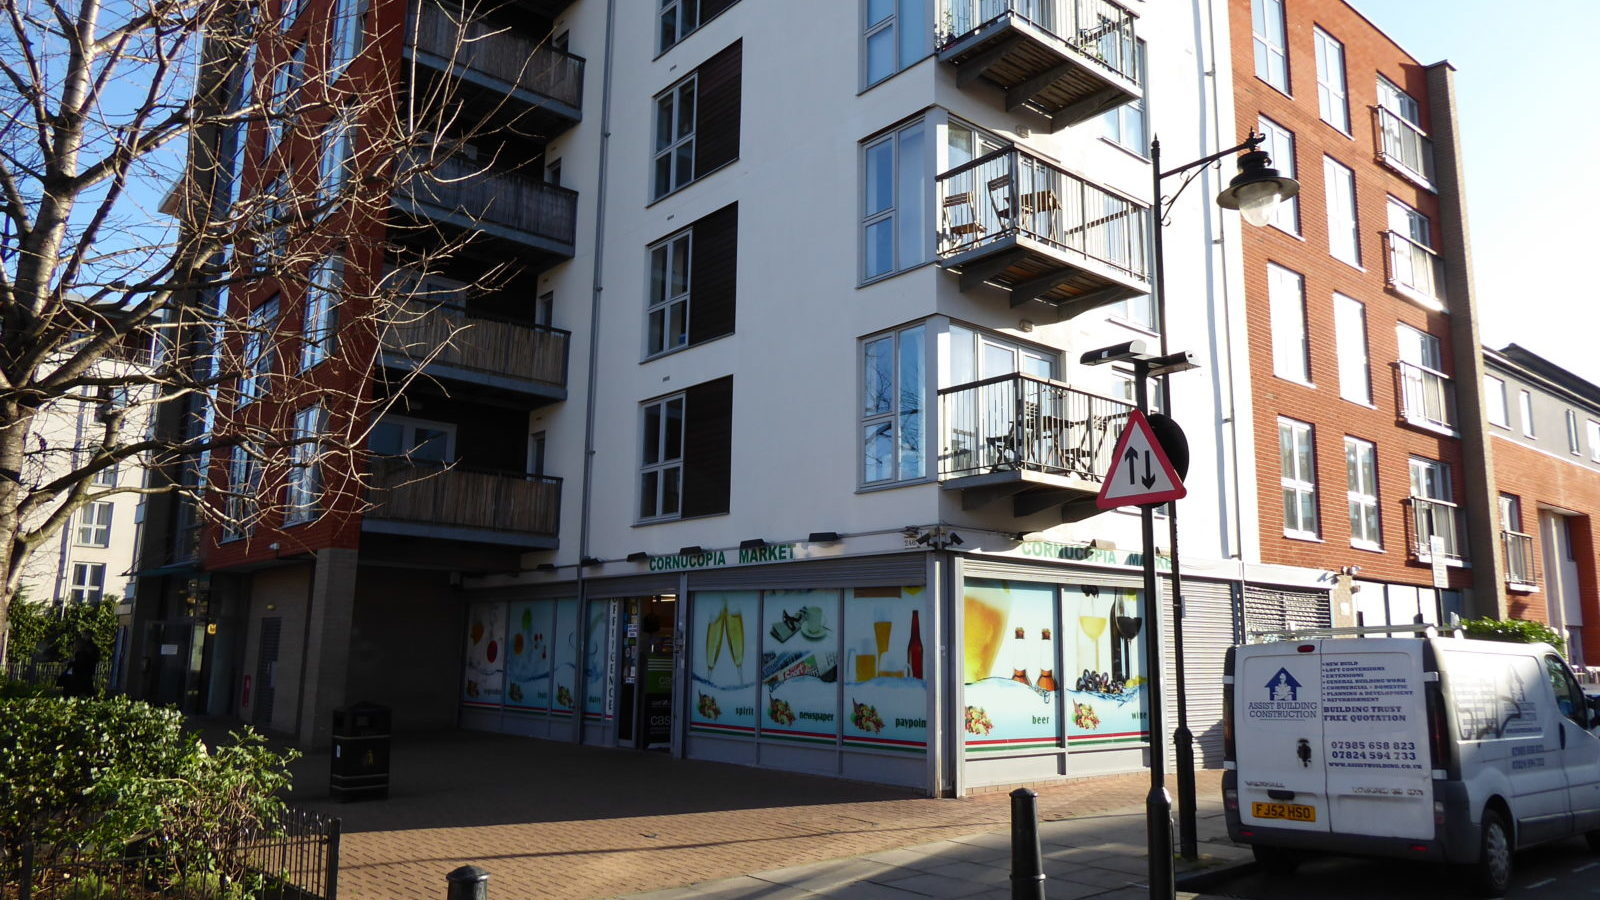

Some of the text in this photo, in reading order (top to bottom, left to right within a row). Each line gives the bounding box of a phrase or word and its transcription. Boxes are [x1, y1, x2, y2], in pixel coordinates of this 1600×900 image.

[650, 544, 796, 571] CORNUCOPIA MARKET
[1021, 542, 1117, 564] CORNUCOPIA
[735, 706, 754, 716] spirit
[1248, 702, 1317, 710] ASSIST BUILDING
[799, 711, 834, 722] newspaper
[1131, 711, 1148, 720] wine
[1249, 710, 1317, 718] CONSTRUCTION
[895, 717, 927, 729] paypoin
[1032, 715, 1049, 725] beer
[1331, 741, 1415, 750] 07985 658 823
[1331, 751, 1416, 760] 07824 594 733
[1256, 804, 1285, 817] FJ52
